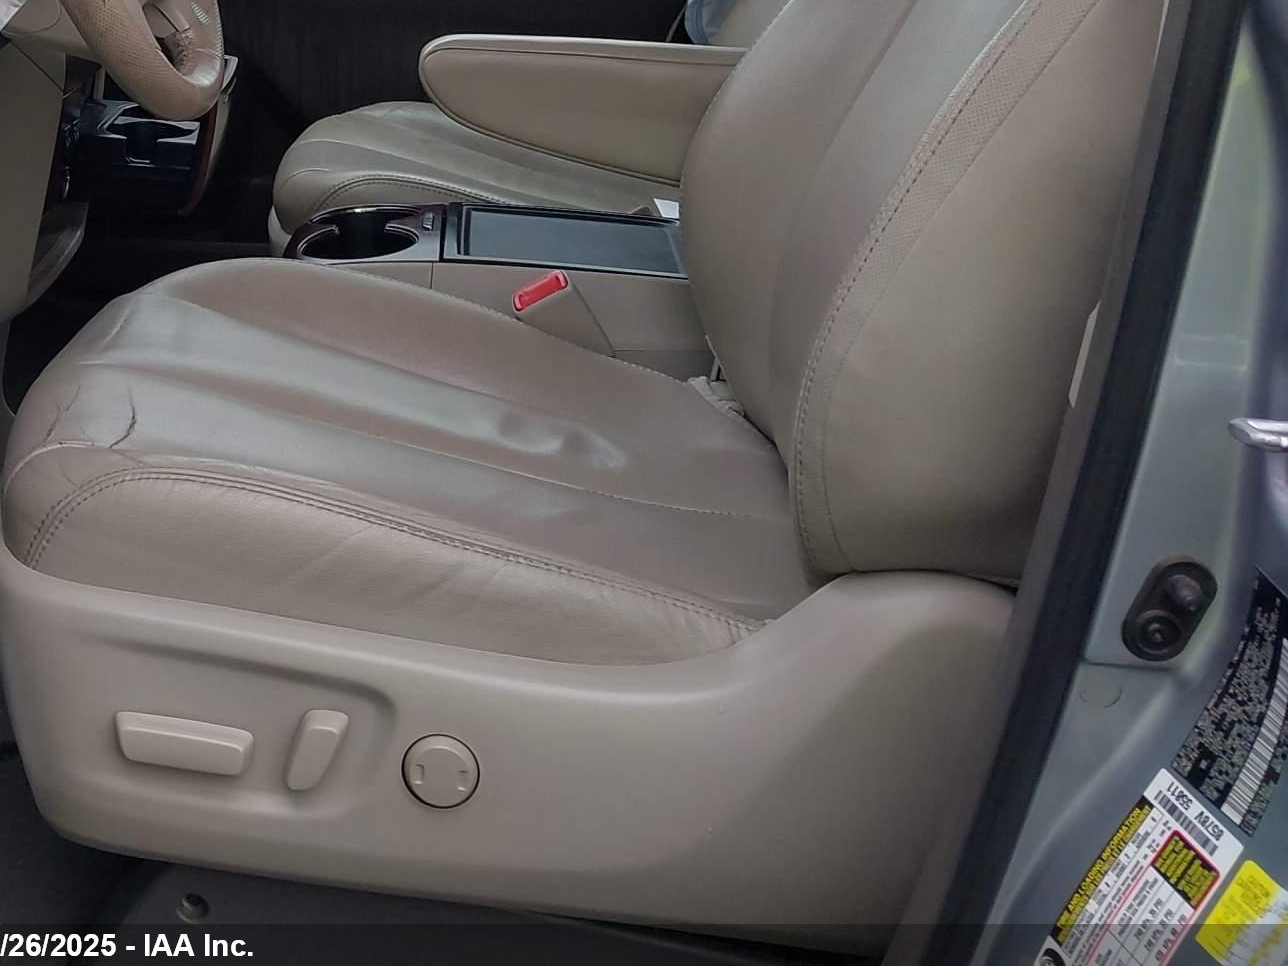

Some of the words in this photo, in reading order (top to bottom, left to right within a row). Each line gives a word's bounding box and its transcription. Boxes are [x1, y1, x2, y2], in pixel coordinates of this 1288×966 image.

[1066, 892, 1082, 911] AND
[1077, 858, 1104, 894] LOADING
[1099, 807, 1142, 860] INFORMATION
